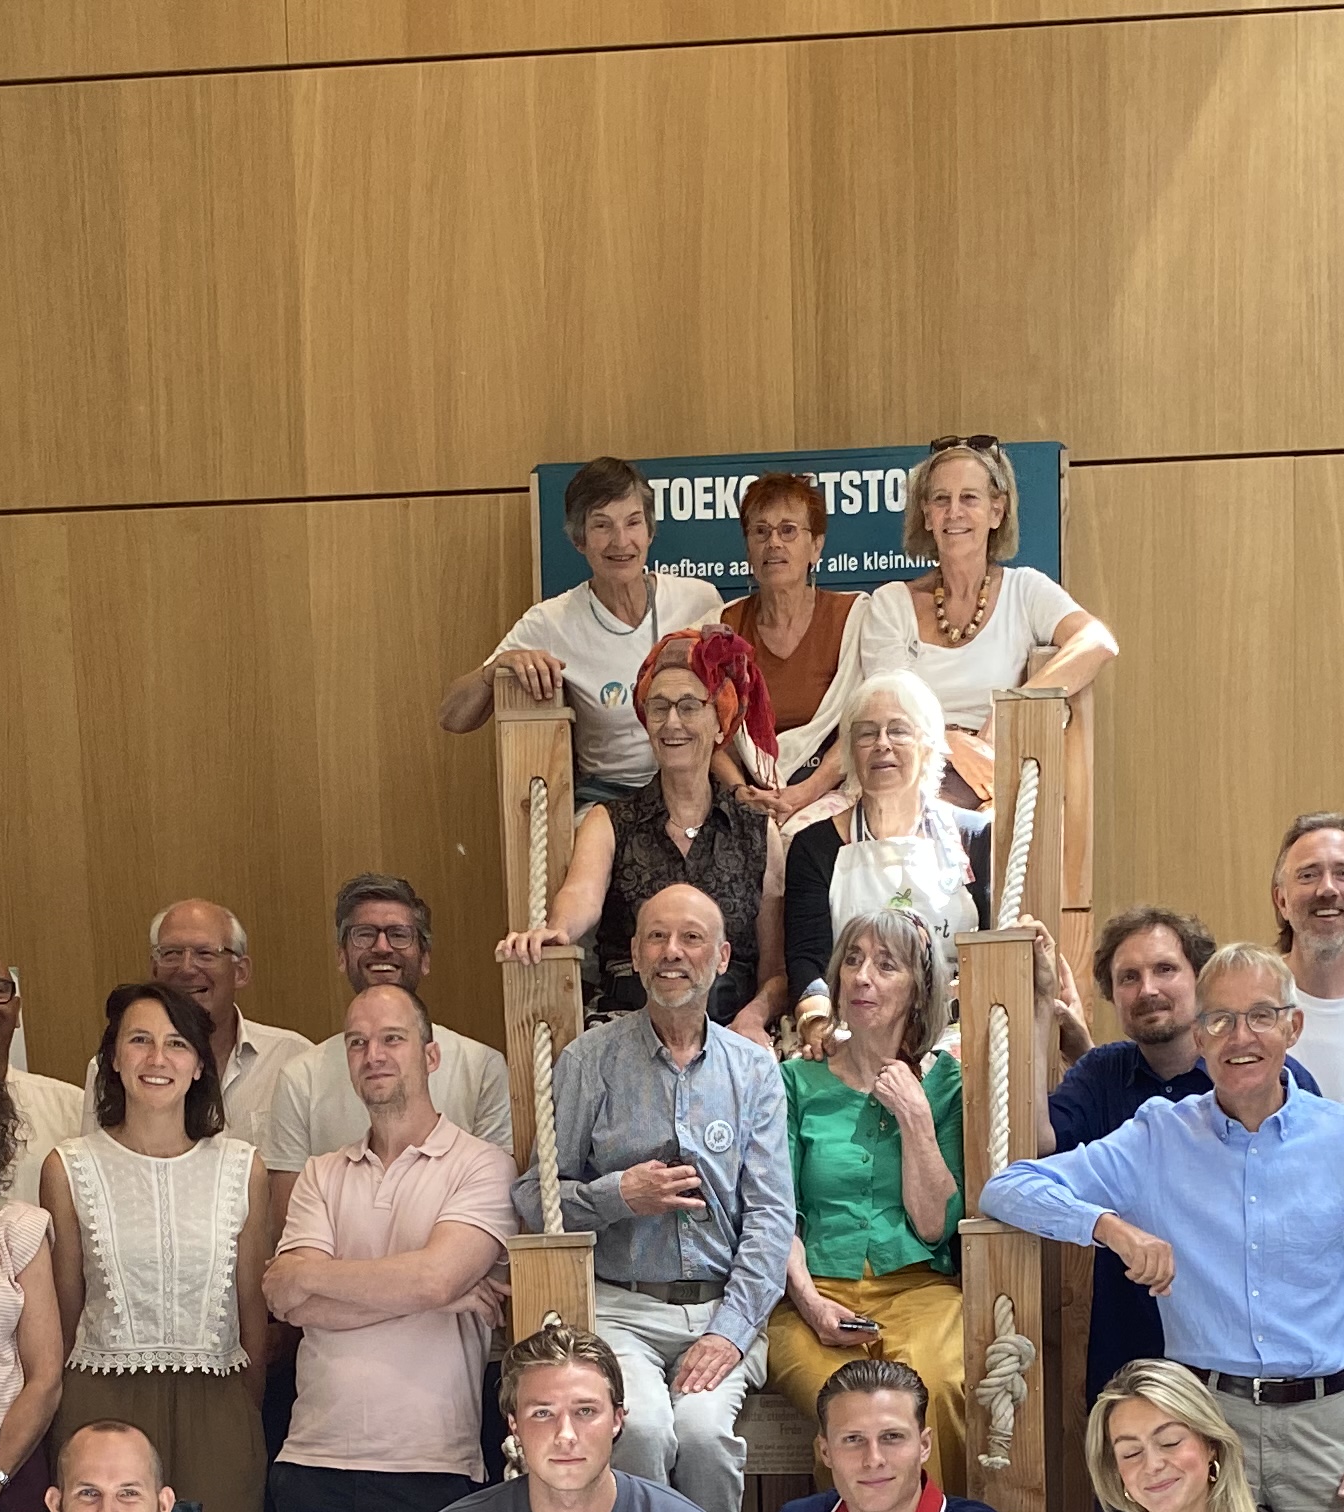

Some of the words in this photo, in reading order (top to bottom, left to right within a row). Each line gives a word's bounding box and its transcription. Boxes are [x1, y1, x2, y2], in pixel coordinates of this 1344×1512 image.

[648, 468, 916, 521] TOEKTSTO
[655, 559, 724, 576] leefbare
[828, 553, 858, 572] alle
